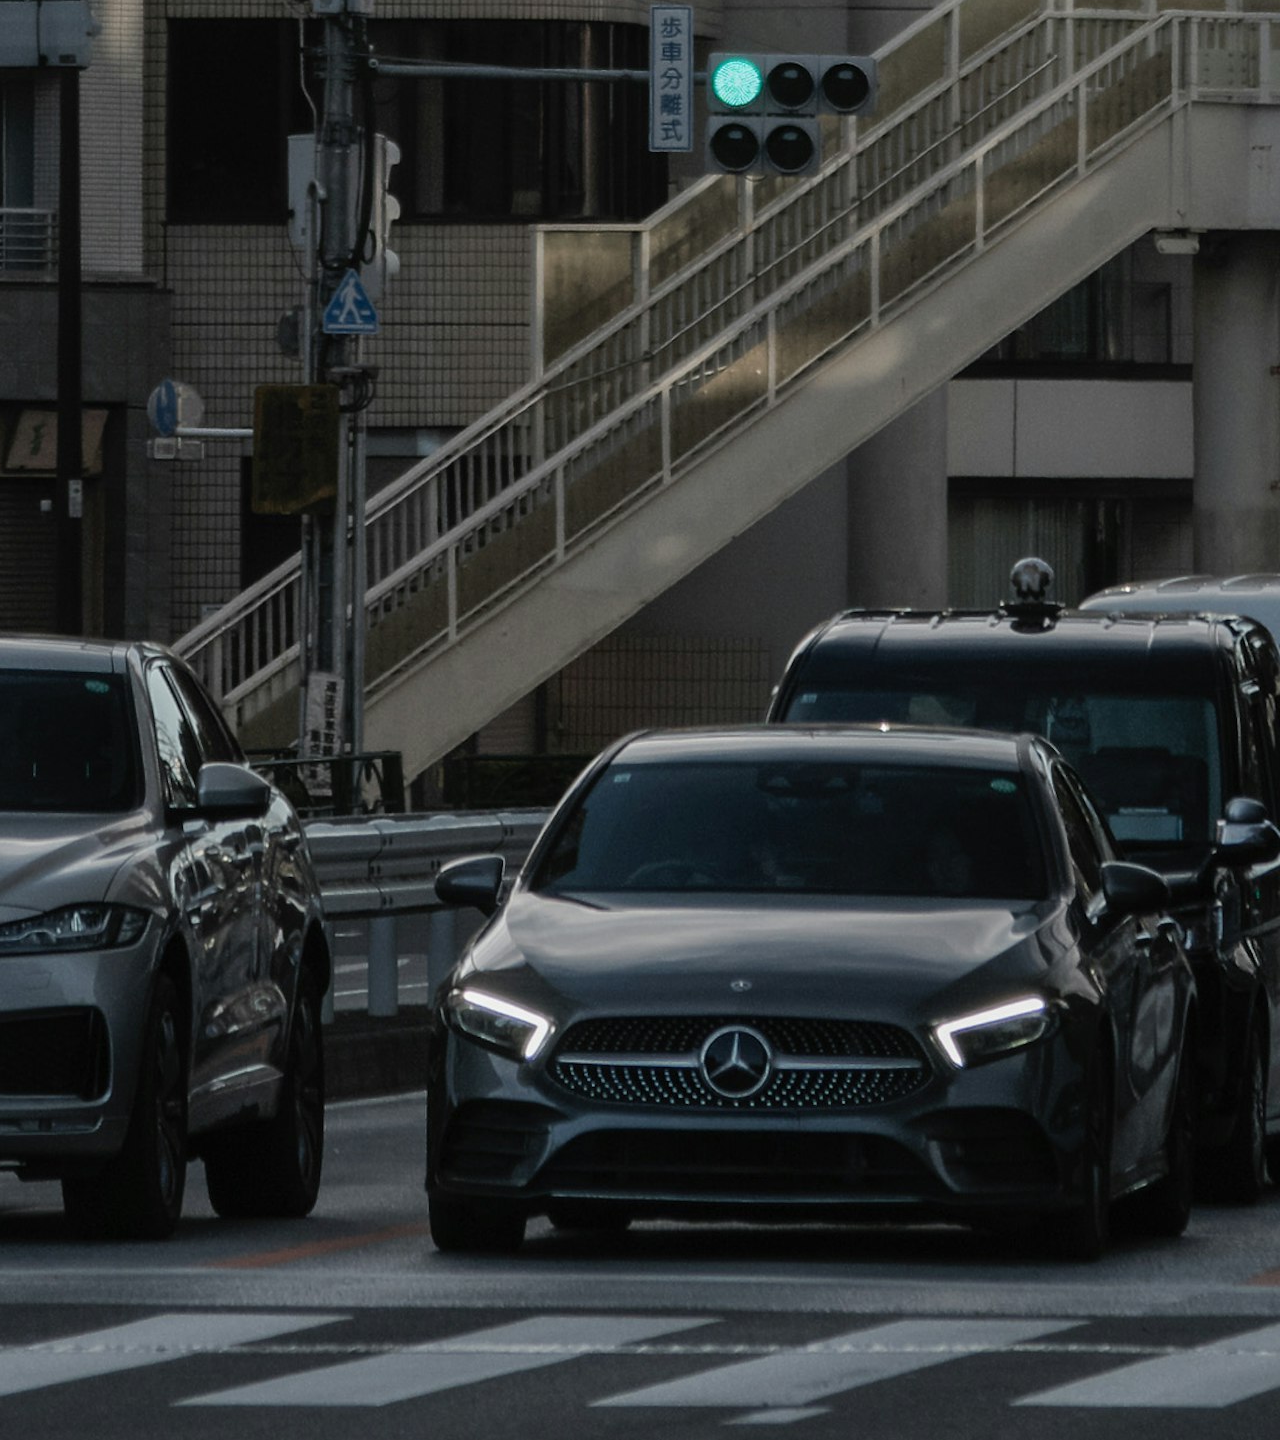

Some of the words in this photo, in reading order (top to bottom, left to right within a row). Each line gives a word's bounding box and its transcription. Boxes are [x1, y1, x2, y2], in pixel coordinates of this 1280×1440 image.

[660, 16, 683, 143] 歩車分離式
